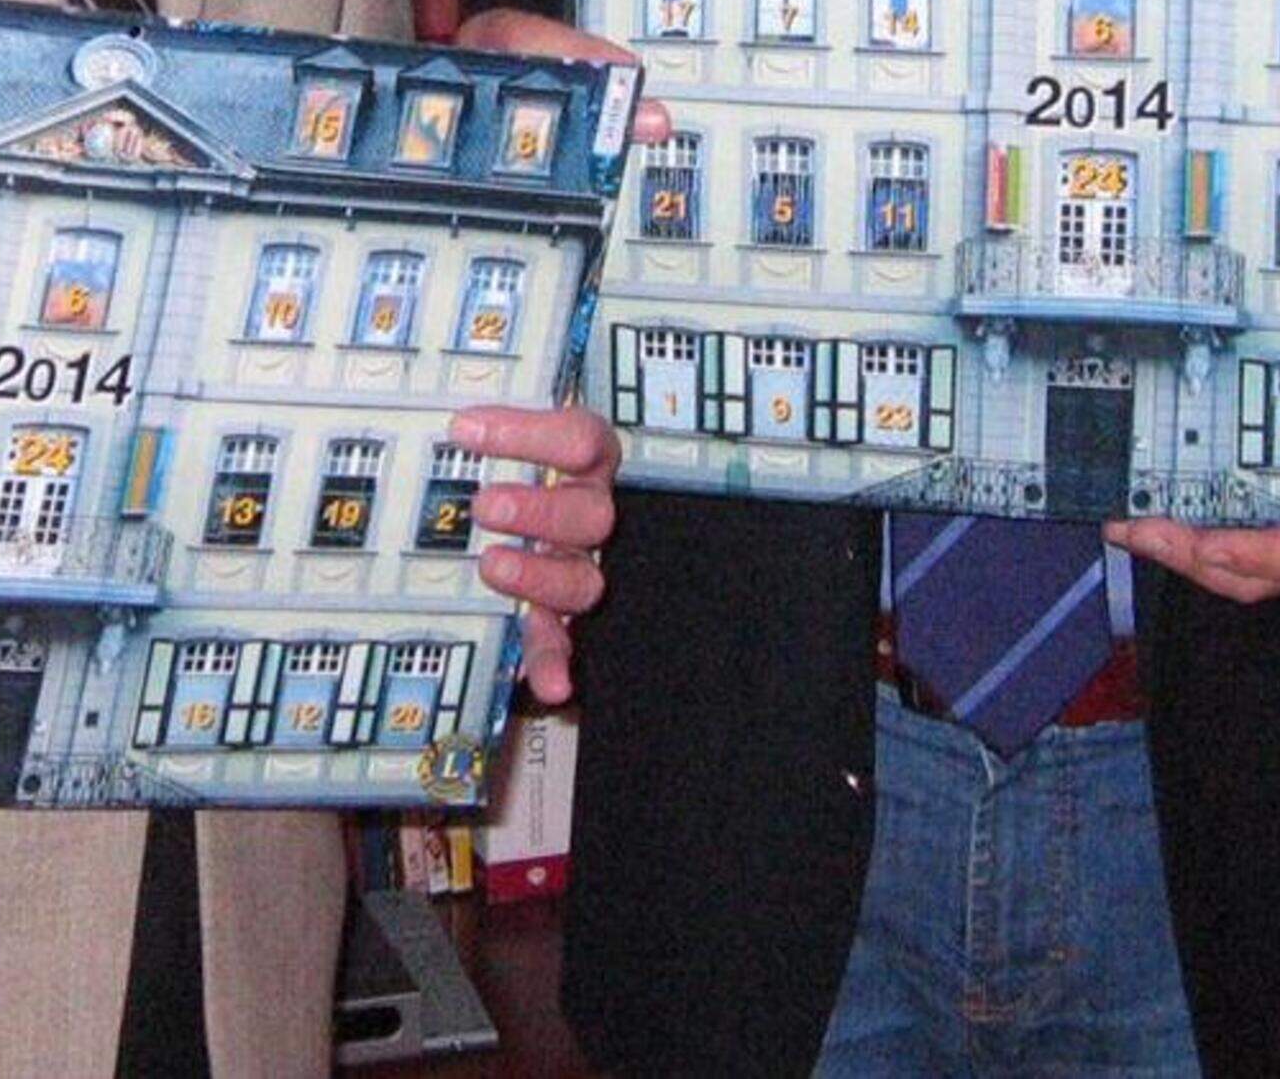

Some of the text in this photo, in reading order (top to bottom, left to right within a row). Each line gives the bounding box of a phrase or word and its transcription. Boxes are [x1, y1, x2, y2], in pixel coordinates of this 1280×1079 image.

[1023, 76, 1175, 132] 2014
[306, 109, 341, 144] 15
[1067, 159, 1129, 200] 24
[652, 190, 688, 219] 21
[772, 196, 795, 223] 5
[881, 203, 918, 231] 11
[264, 294, 299, 330] 10
[470, 311, 507, 342] 22
[874, 403, 914, 431] 23
[12, 438, 74, 478] 24
[220, 499, 256, 526] 13
[323, 499, 360, 528] 19
[436, 504, 454, 532] 2
[182, 703, 216, 729] 16
[289, 704, 324, 731] 12
[390, 705, 425, 732] 20
